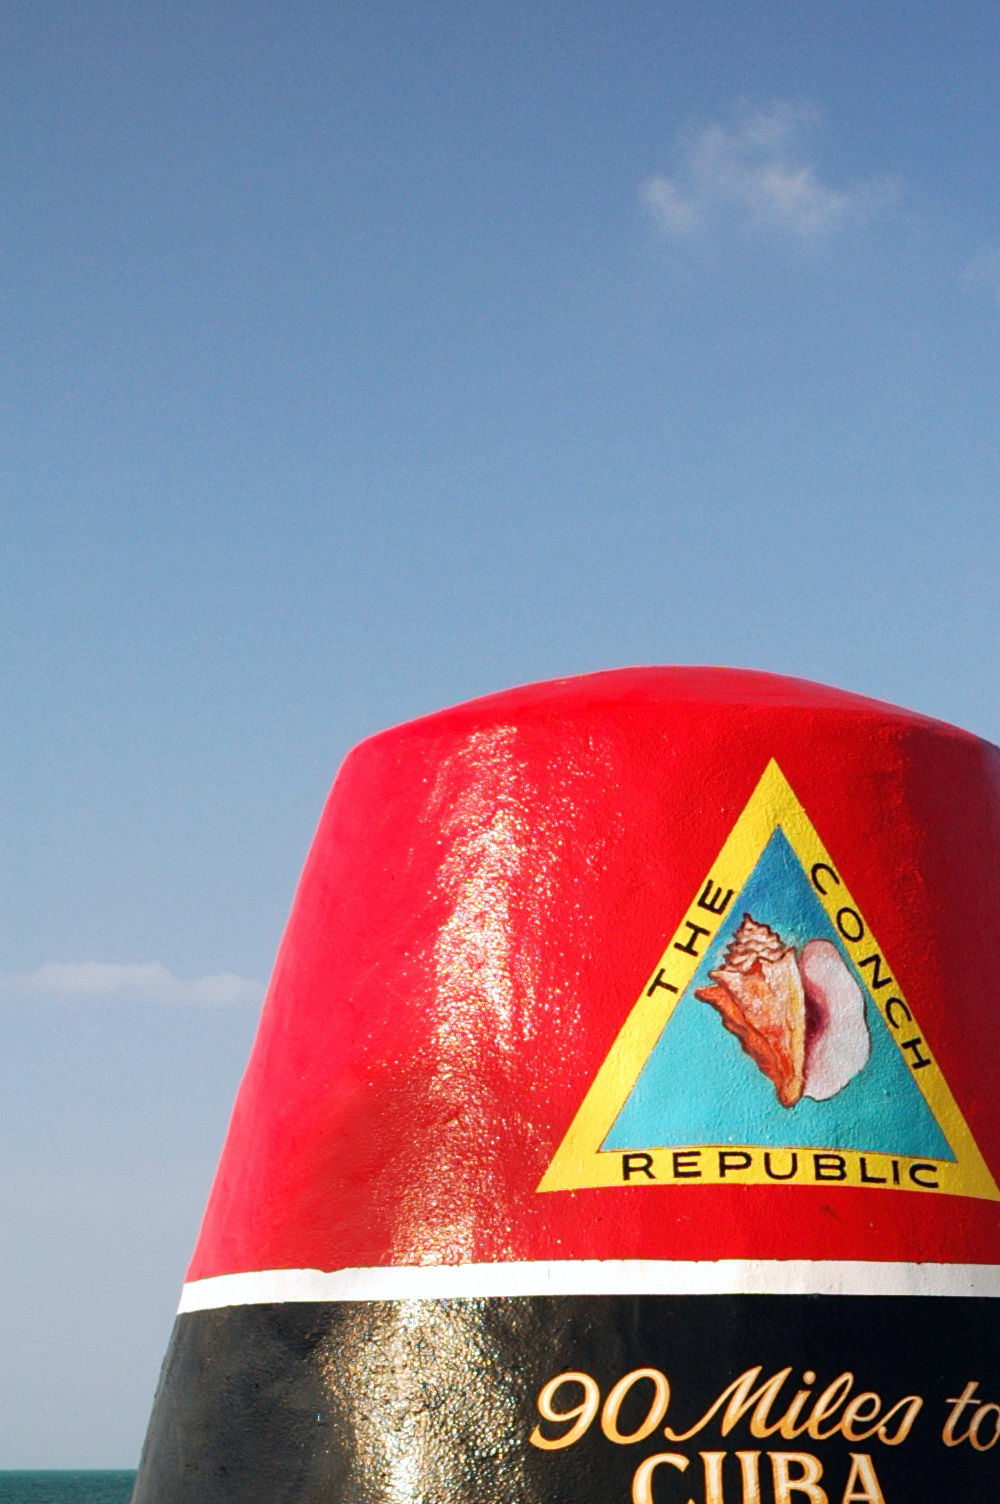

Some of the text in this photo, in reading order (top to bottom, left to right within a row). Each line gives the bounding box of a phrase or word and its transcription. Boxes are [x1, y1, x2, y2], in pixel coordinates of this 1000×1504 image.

[647, 879, 734, 998] THE
[811, 862, 932, 1070] CONCH
[621, 1151, 939, 1189] REPUBLIC
[530, 1366, 671, 1451] 90
[664, 1364, 922, 1447] Miles
